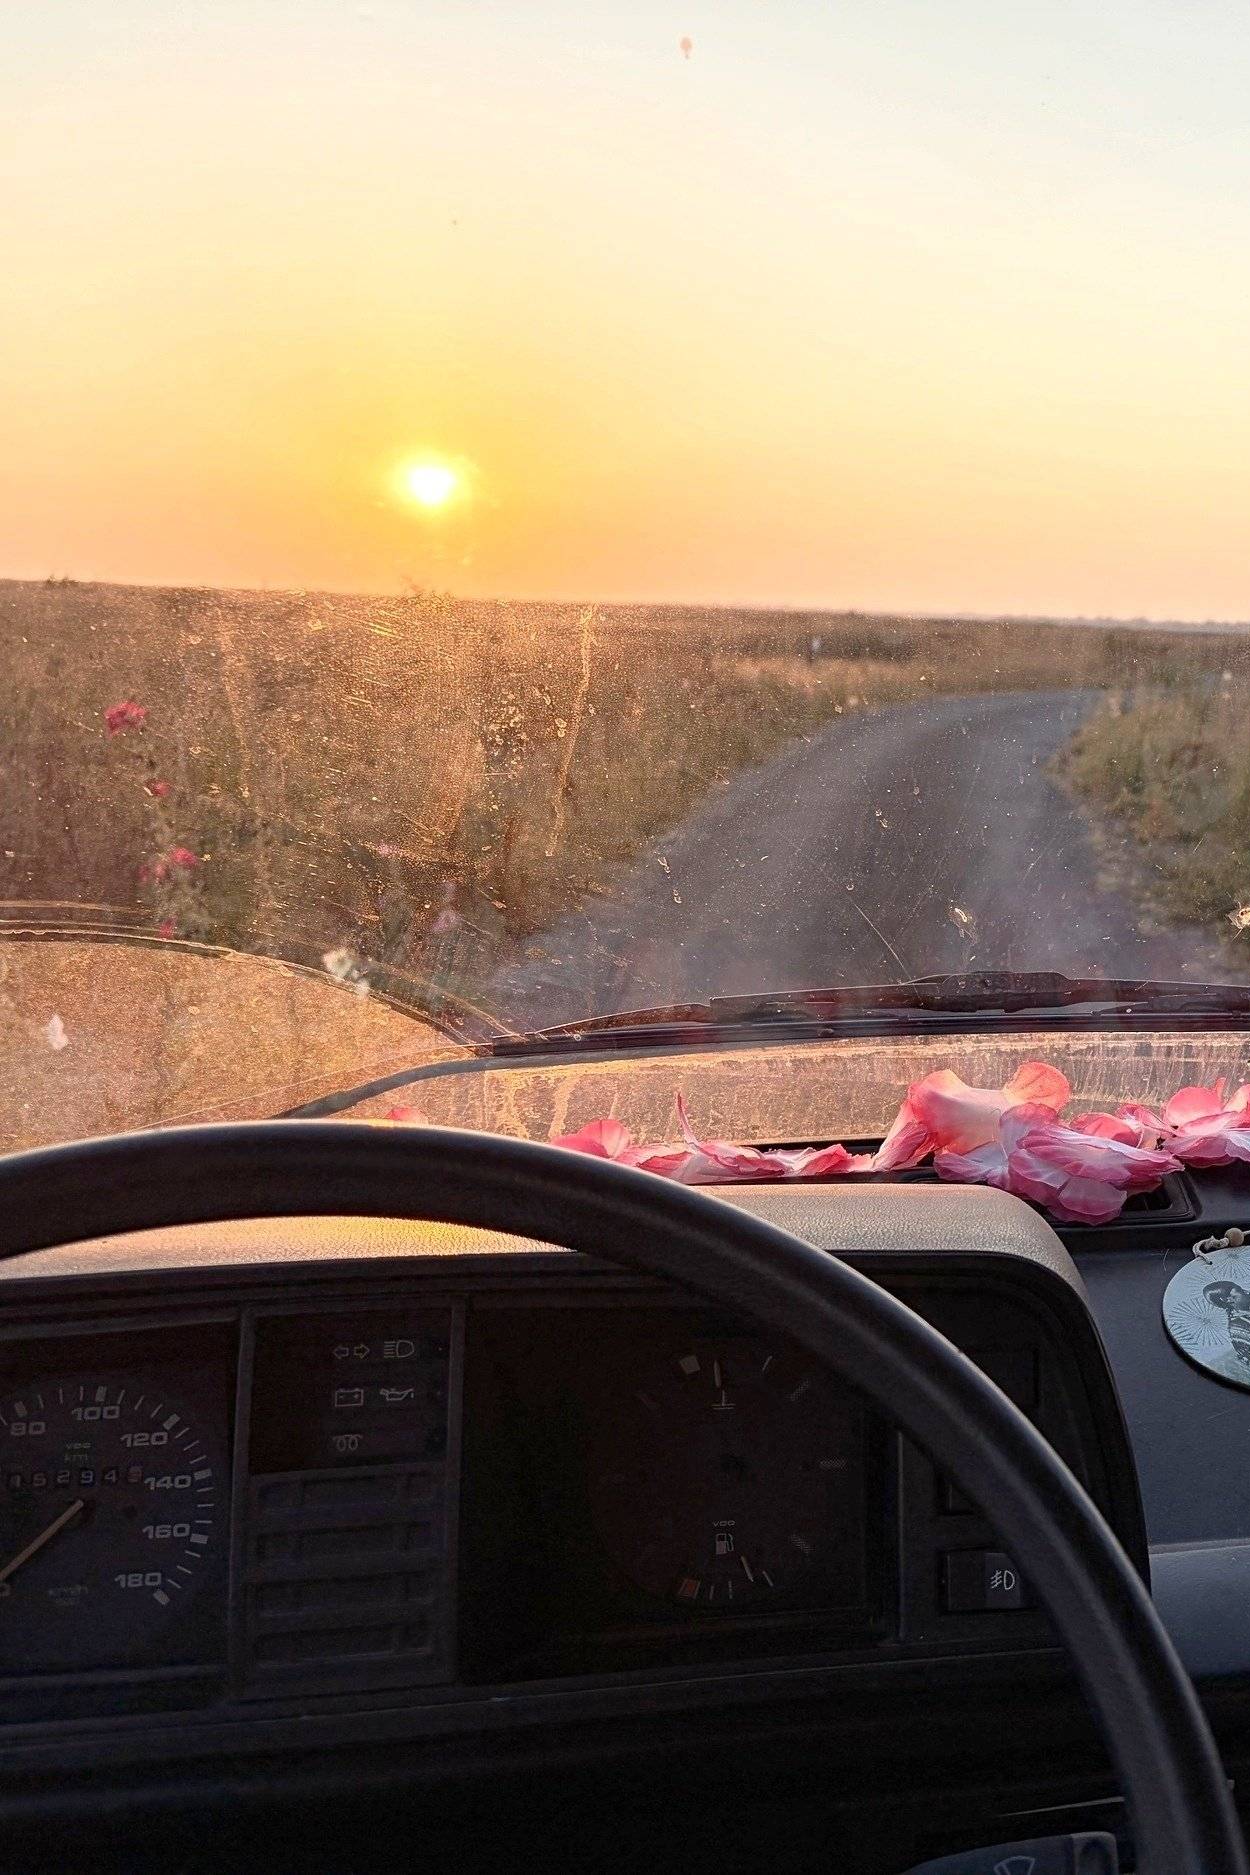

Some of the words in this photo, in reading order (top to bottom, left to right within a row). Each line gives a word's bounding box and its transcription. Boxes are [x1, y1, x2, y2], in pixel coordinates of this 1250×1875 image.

[71, 1405, 120, 1421] 100
[120, 1431, 169, 1448] 120
[144, 1474, 192, 1490] 140
[142, 1523, 191, 1539] 160
[114, 1572, 163, 1588] 180
